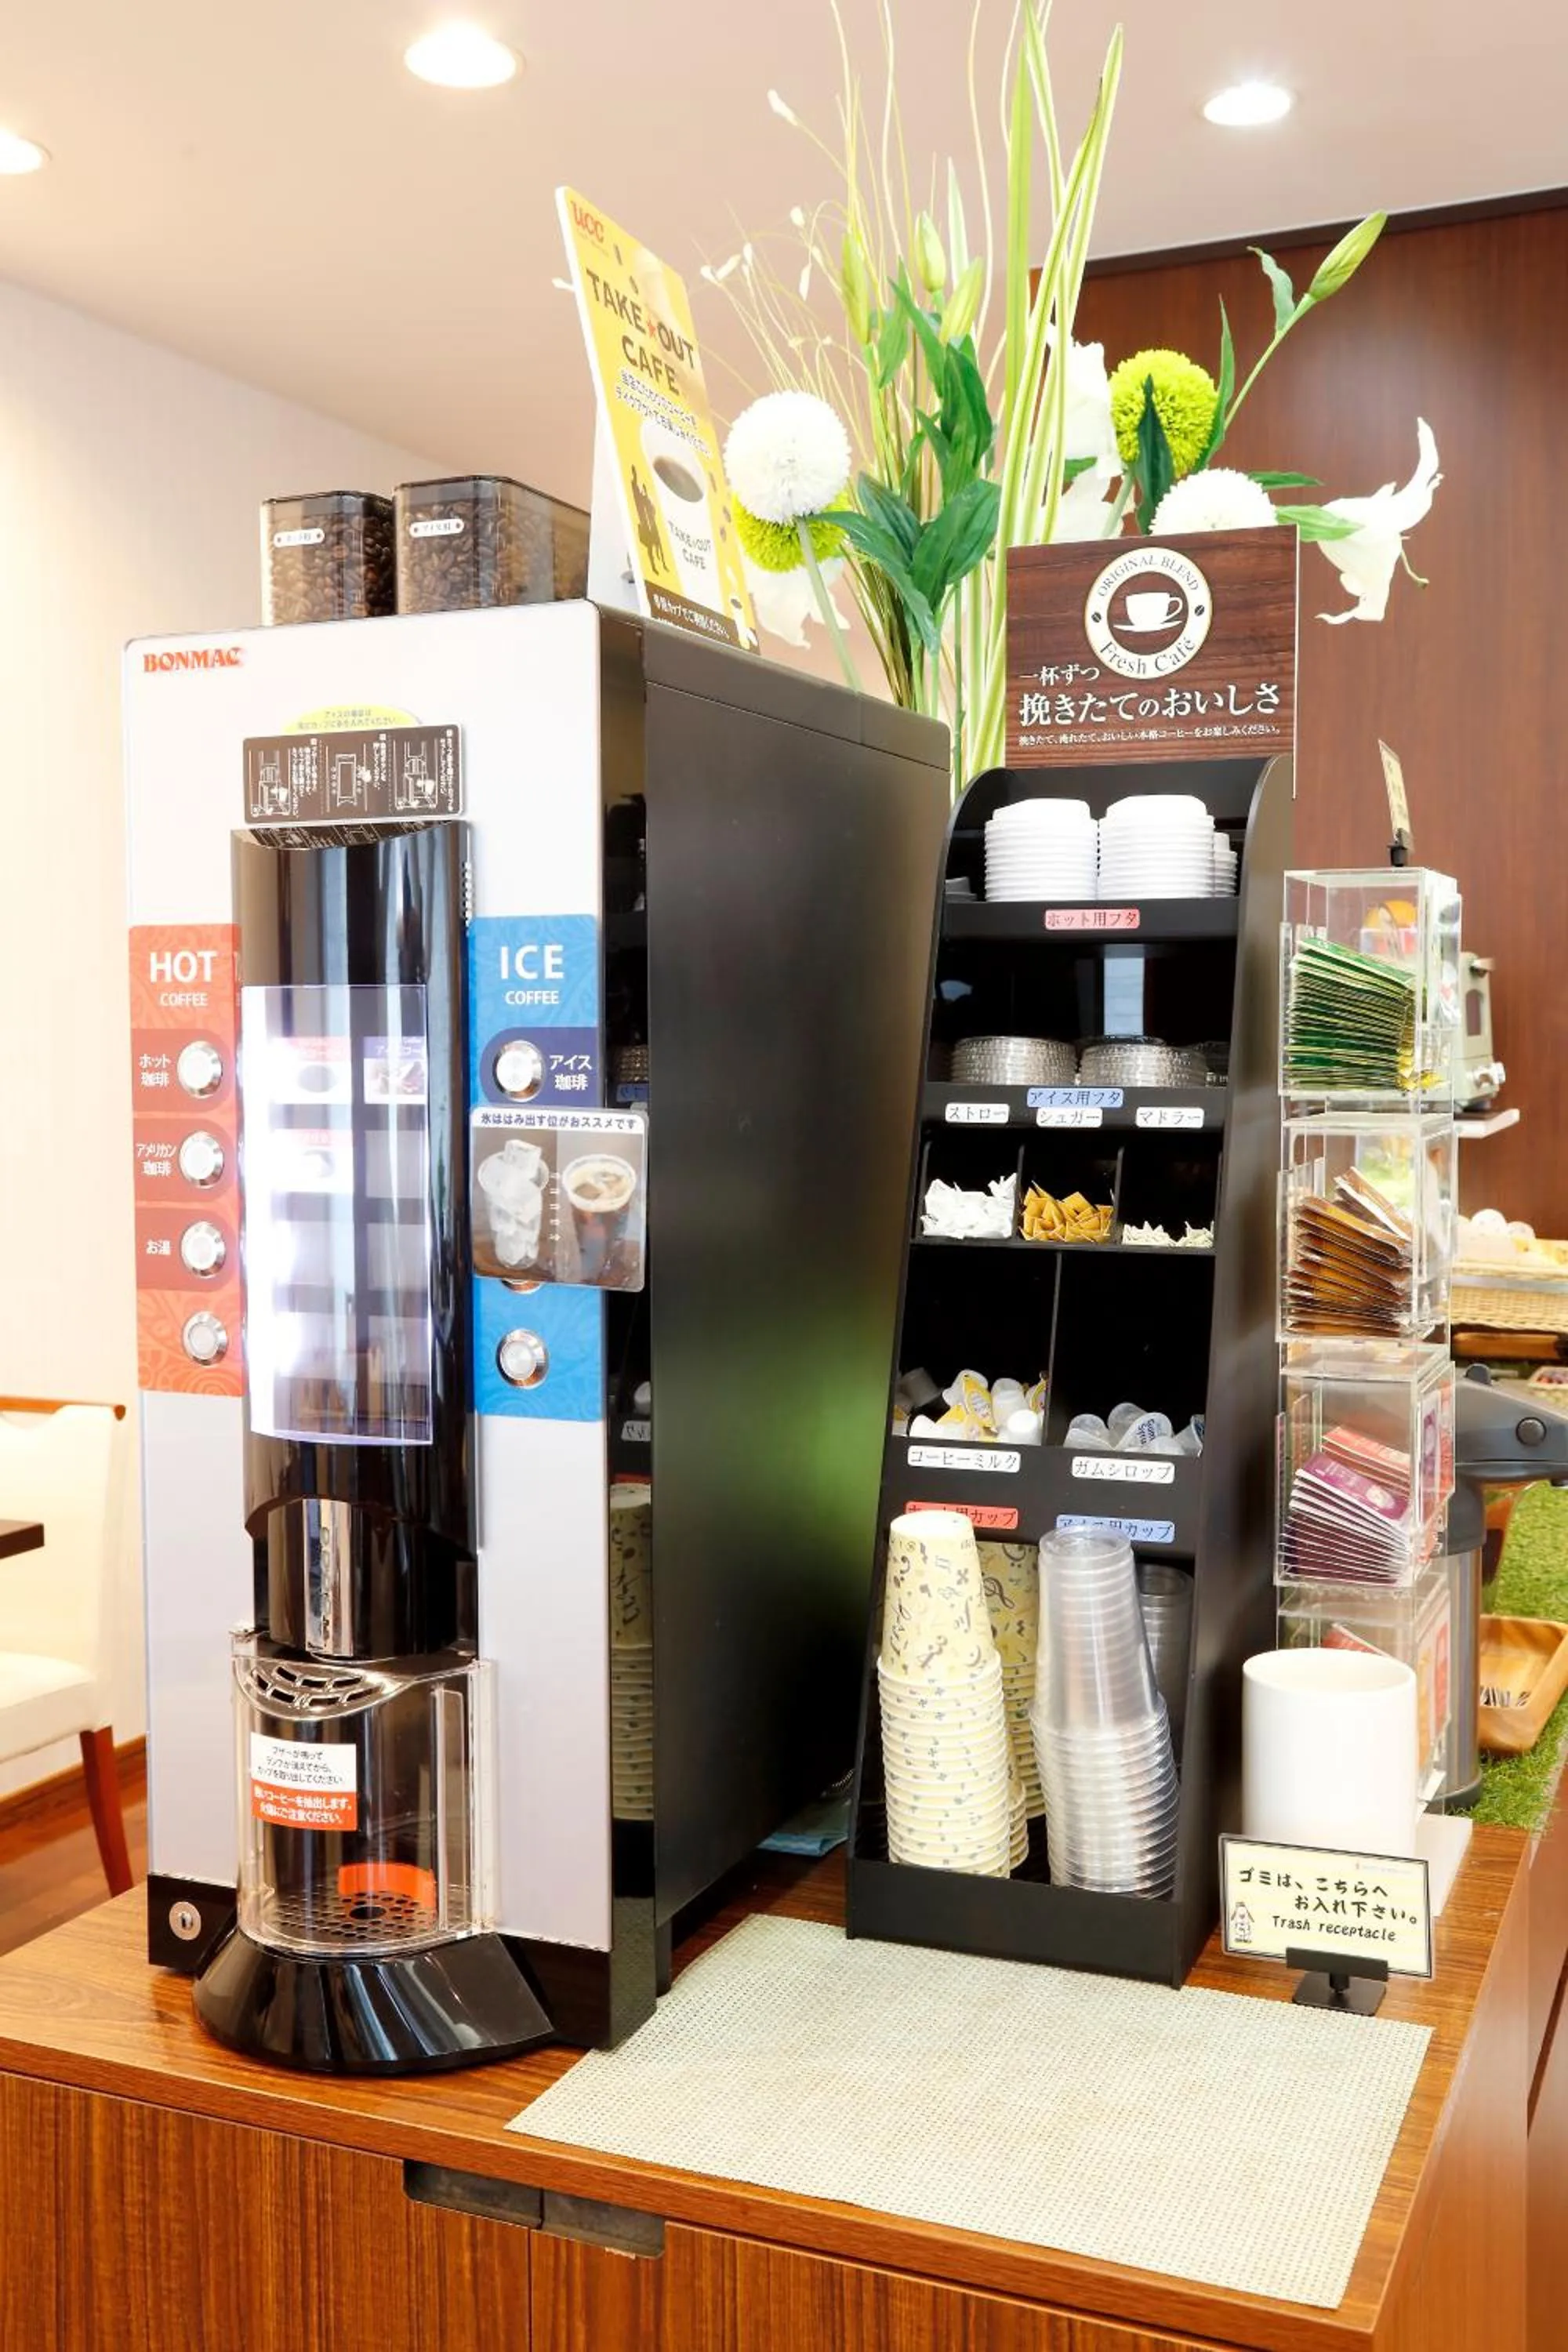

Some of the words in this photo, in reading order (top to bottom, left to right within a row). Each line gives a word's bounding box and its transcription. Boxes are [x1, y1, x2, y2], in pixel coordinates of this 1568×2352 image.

[571, 199, 604, 243] UCC
[586, 268, 646, 335] TAKE
[657, 321, 695, 369] OUT
[621, 335, 681, 396] CAFE
[1098, 554, 1158, 597] ORIGINAL
[1160, 555, 1200, 591] BLEND
[143, 647, 243, 673] BONMAC
[1100, 641, 1147, 675] Fresh
[1020, 664, 1101, 687] 一杯ずつ
[1019, 683, 1281, 727] 挽きたてのおいしさ
[1047, 911, 1138, 928] ホット用フタ
[149, 950, 217, 982] HOT
[499, 944, 564, 980] ICE
[159, 992, 209, 1007] COFFEE
[505, 989, 560, 1005] COFFEE
[139, 1053, 171, 1069] ホット
[549, 1054, 593, 1070] アイス
[554, 1073, 588, 1091] 珈琲
[1029, 1089, 1121, 1106] アイス用フタ
[947, 1106, 1008, 1120] ストロー
[1039, 1109, 1100, 1125] シュガー
[1139, 1109, 1202, 1125] マドラー
[136, 1142, 176, 1158] アメリカン
[146, 1239, 171, 1256] お湯
[910, 1450, 1018, 1470] コーヒーミルク
[1075, 1460, 1172, 1480] ガムシロップ
[1294, 1894, 1417, 1925] お入れ下さい。
[1272, 1915, 1311, 1931] Trash
[1318, 1921, 1397, 1942] receptacle
